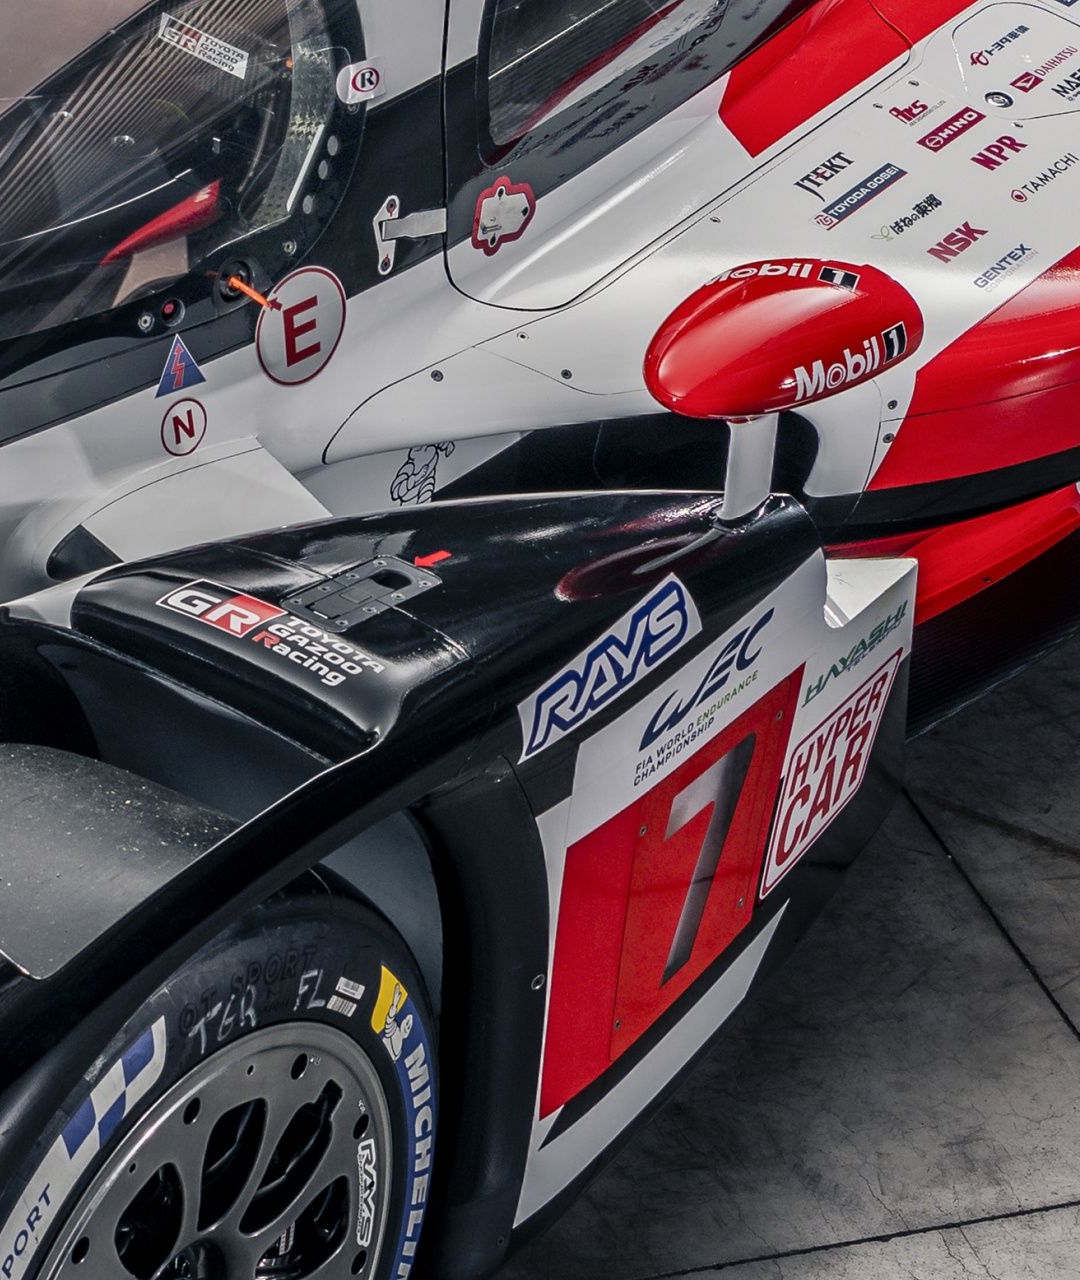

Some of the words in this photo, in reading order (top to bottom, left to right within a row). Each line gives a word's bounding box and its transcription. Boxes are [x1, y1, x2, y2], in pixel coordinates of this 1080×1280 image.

[199, 49, 235, 72] Racing
[200, 42, 239, 64] GAZOO
[205, 36, 244, 60] TOYOTA
[1034, 46, 1077, 76] DAIHATSU
[938, 111, 978, 138] HINO
[793, 152, 855, 202] JTEKT
[970, 135, 1028, 171] NPR
[1021, 153, 1079, 194] TAMACHI
[828, 186, 871, 216] TOYODA
[866, 166, 900, 189] GOSEI
[926, 221, 989, 263] NSK
[973, 243, 1032, 289] GENTEX
[282, 295, 321, 367] E
[794, 336, 880, 401] Mobil
[171, 410, 195, 446] N
[167, 590, 262, 632] GR
[252, 631, 347, 687] Racing
[267, 623, 363, 675] GAZOO
[288, 615, 385, 674] TOYOTA
[526, 580, 688, 756] RAYS
[802, 600, 908, 708] HAYASHI
[638, 608, 775, 752] WEC
[635, 755, 653, 774] FIA
[656, 722, 694, 758] WORLD
[696, 669, 758, 726] ENDURANCE
[788, 670, 888, 800] HYPER
[633, 717, 715, 787] CHAMPIONSHIP
[776, 720, 872, 867] CAR
[659, 732, 757, 989] 7
[358, 1138, 376, 1247] RAYS
